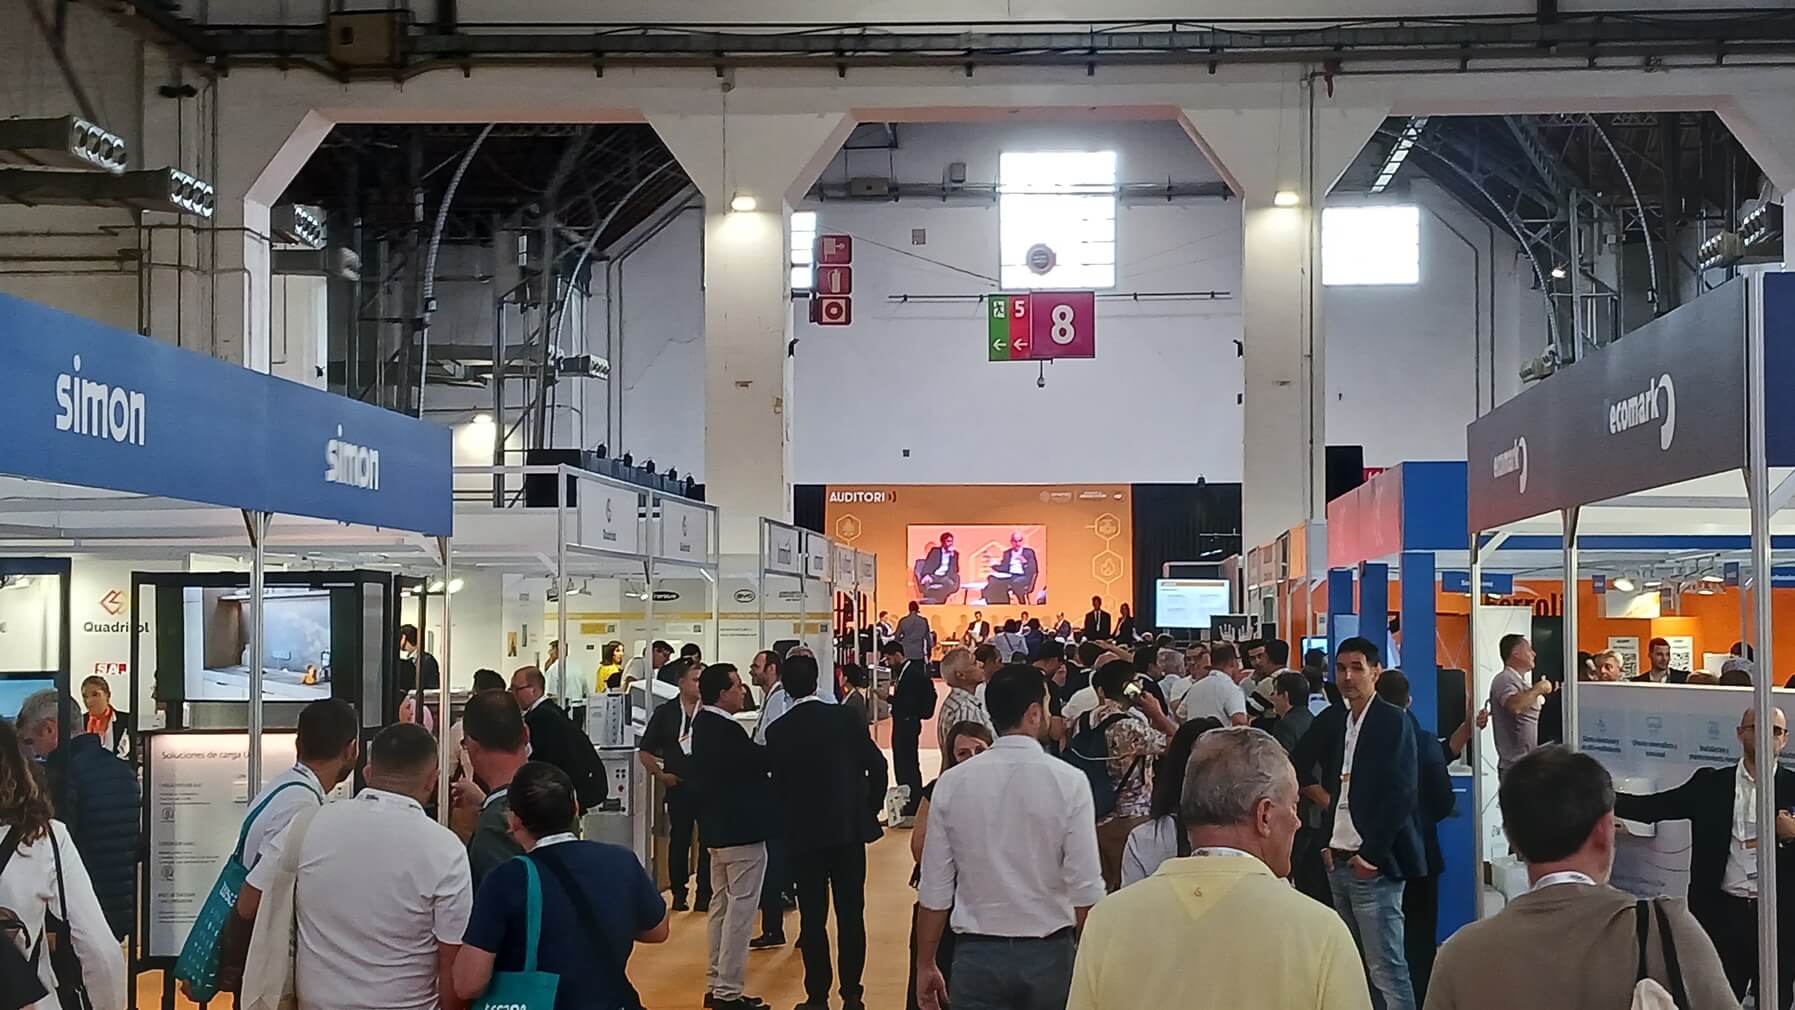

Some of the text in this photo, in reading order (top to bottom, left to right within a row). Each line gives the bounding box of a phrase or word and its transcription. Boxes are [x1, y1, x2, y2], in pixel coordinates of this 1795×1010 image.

[1014, 300, 1025, 318] 5
[1051, 304, 1075, 345] 8
[54, 354, 147, 446] simon
[1609, 372, 1666, 434] ecomark
[325, 423, 380, 490] simon
[829, 491, 886, 503] AUDITORI
[83, 622, 150, 633] Quadriol
